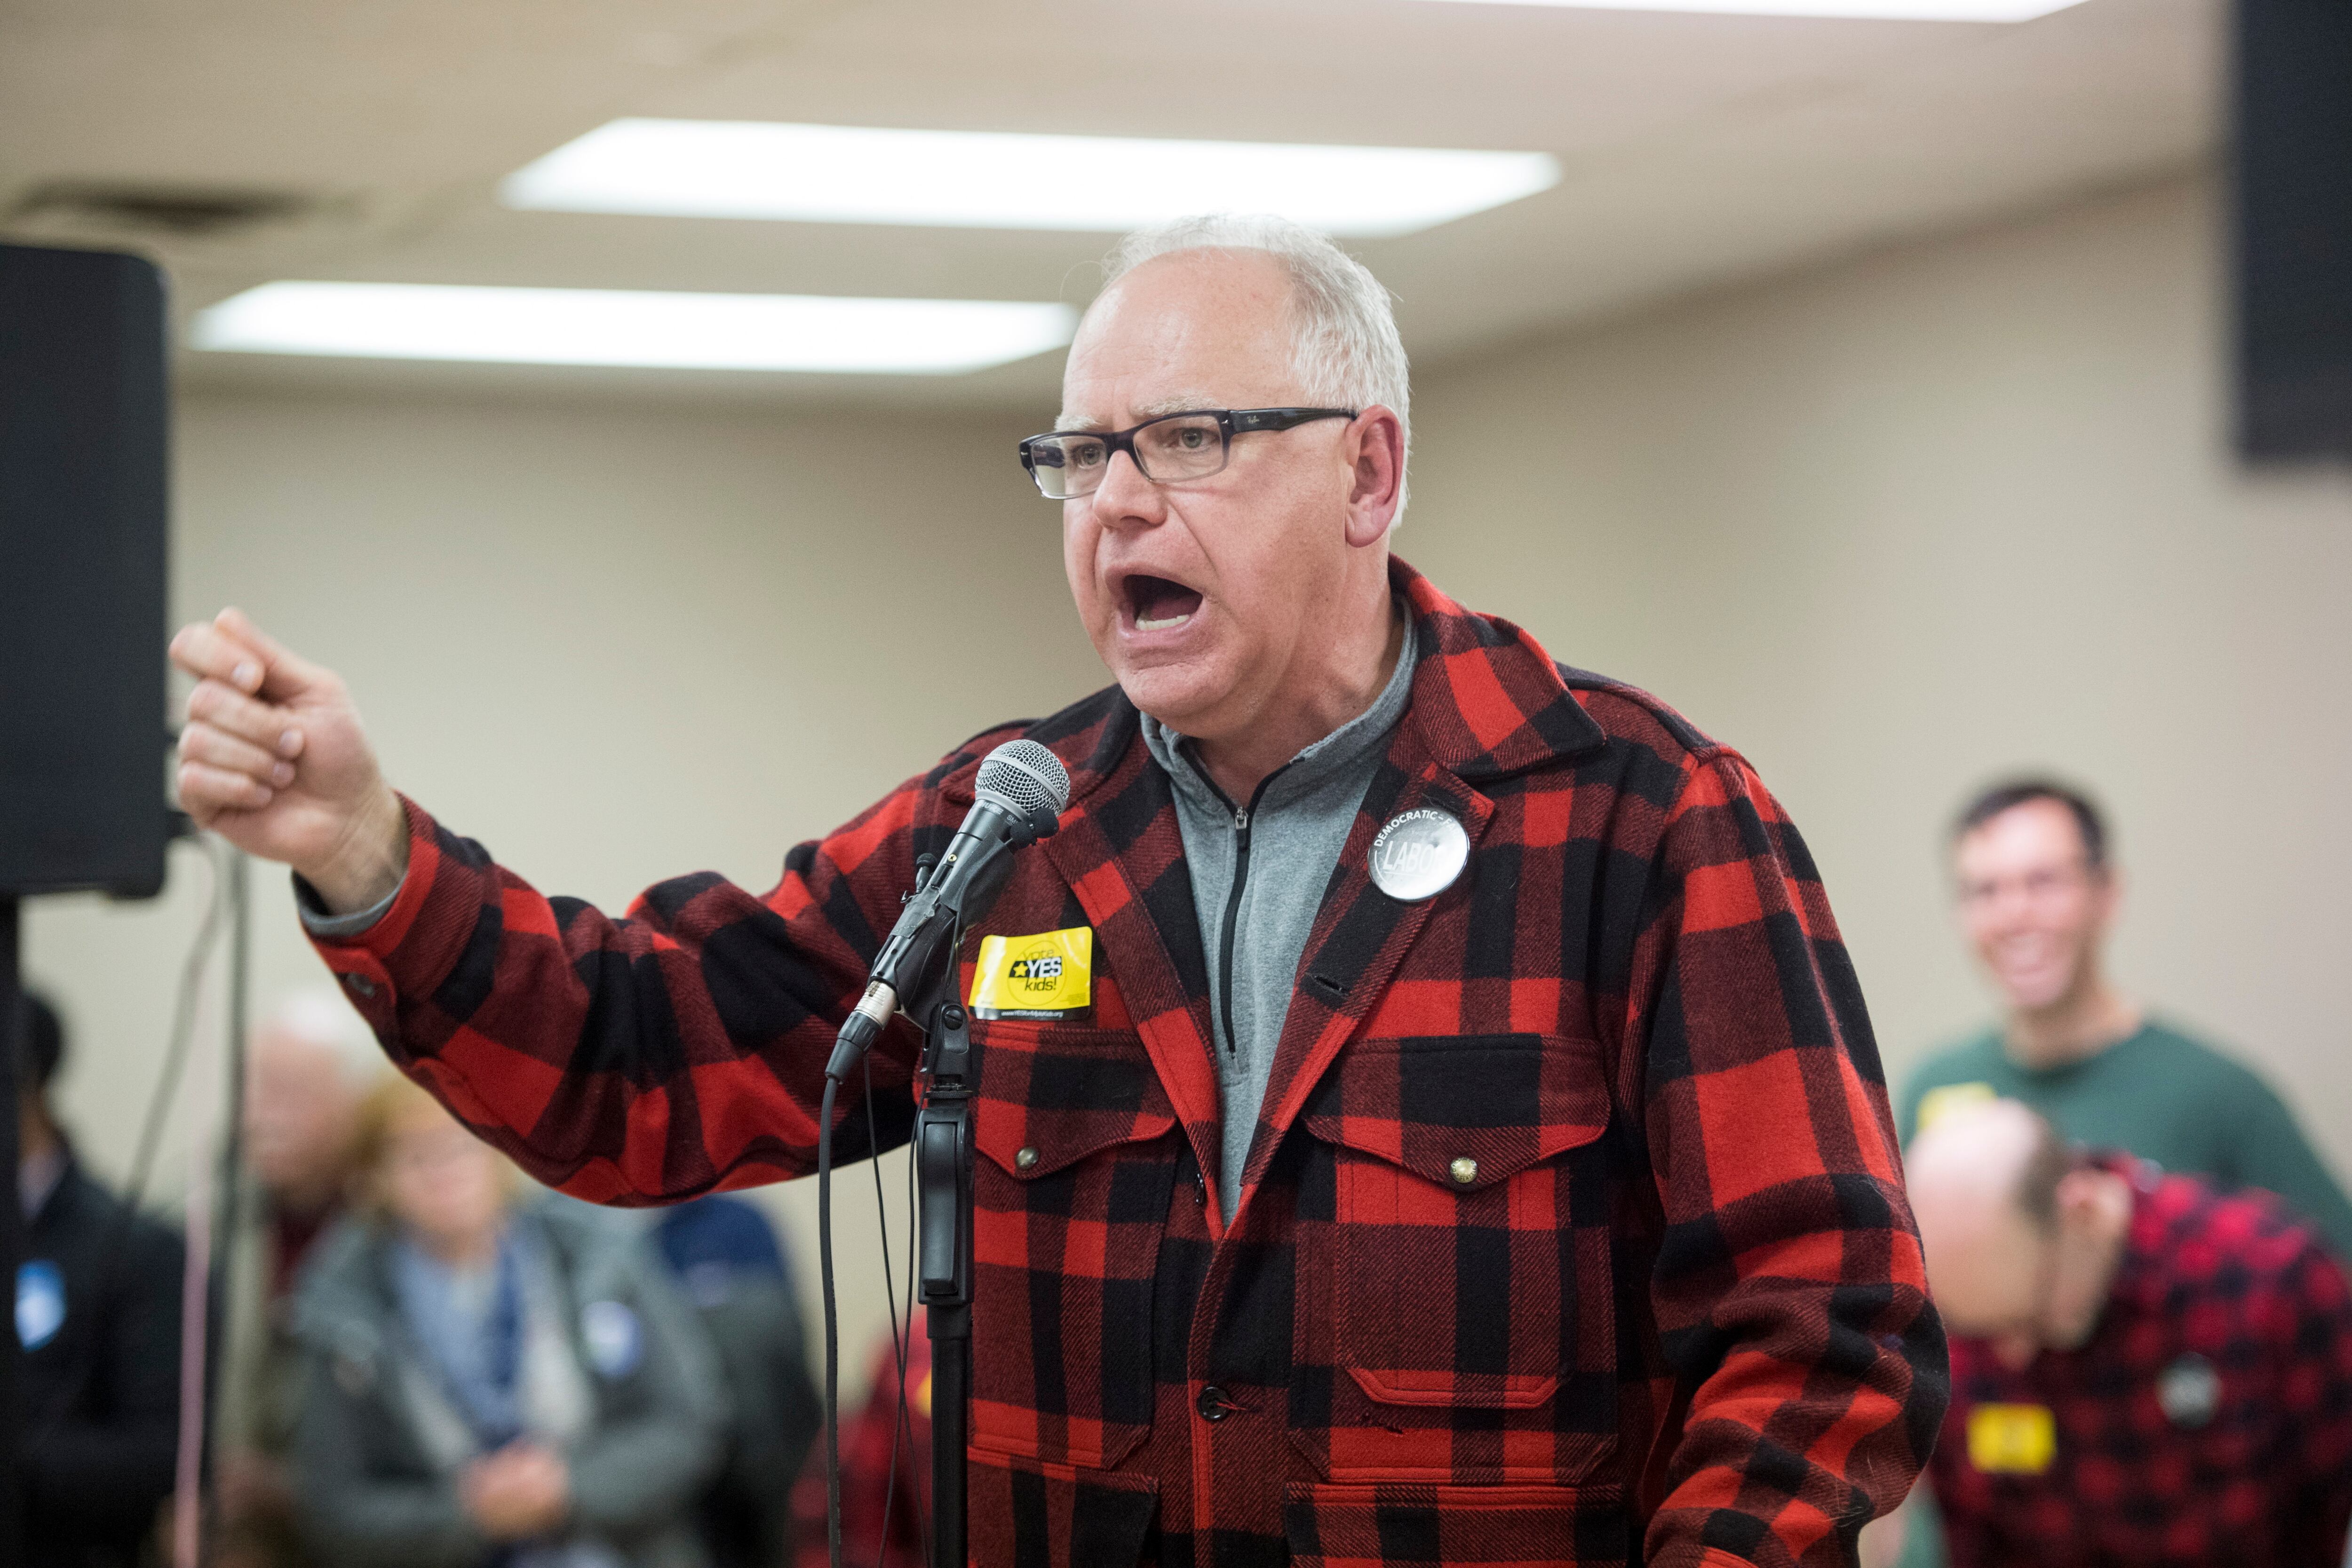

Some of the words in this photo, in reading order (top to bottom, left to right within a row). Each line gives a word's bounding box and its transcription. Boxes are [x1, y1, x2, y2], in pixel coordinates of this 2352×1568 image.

[1383, 841, 1439, 874] LABO
[1023, 949, 1054, 959] vote
[1027, 957, 1062, 978] YES
[1025, 977, 1057, 991] kids!
